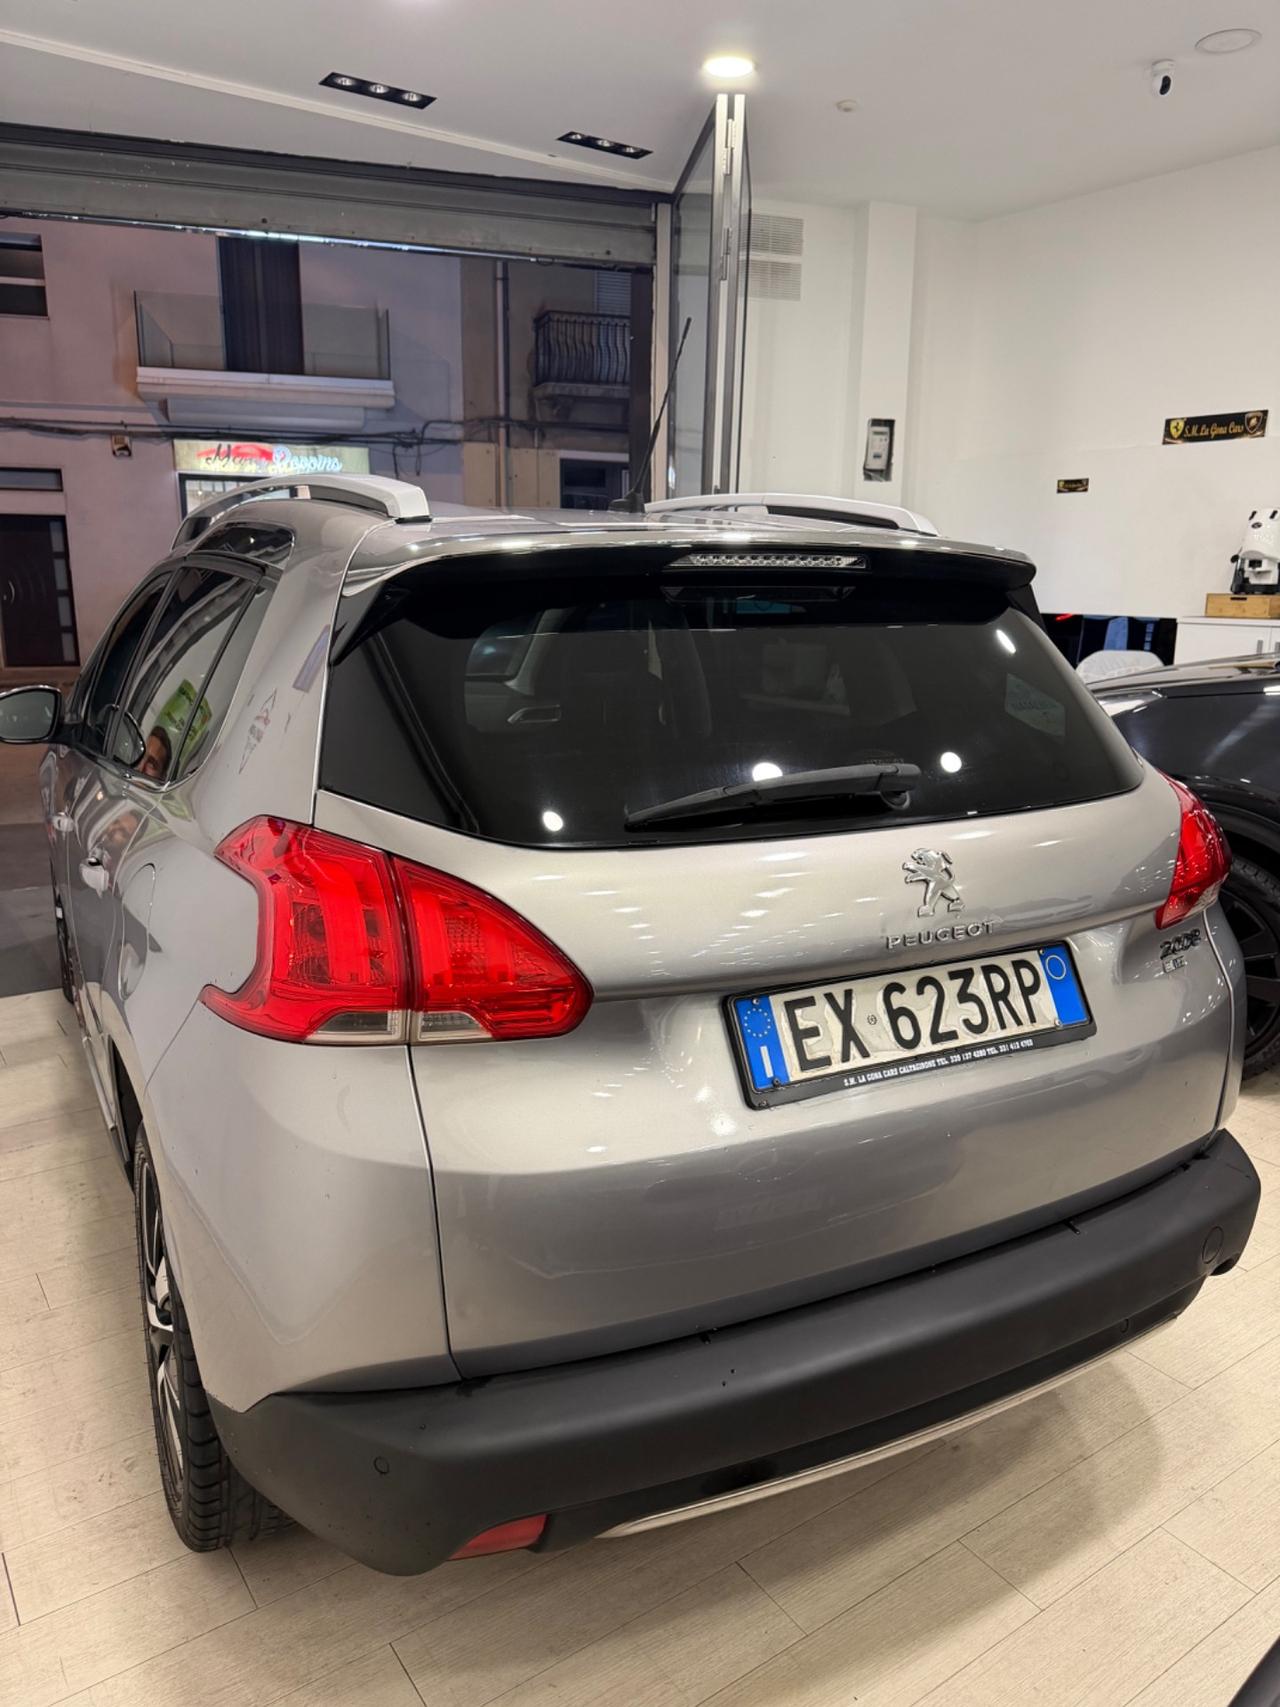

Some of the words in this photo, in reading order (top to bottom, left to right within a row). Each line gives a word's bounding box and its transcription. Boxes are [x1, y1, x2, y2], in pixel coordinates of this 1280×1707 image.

[886, 920, 998, 950] PEUGEOT
[784, 988, 871, 1072] EX
[882, 959, 1042, 1051] 623RP
[882, 1067, 899, 1079] CARS
